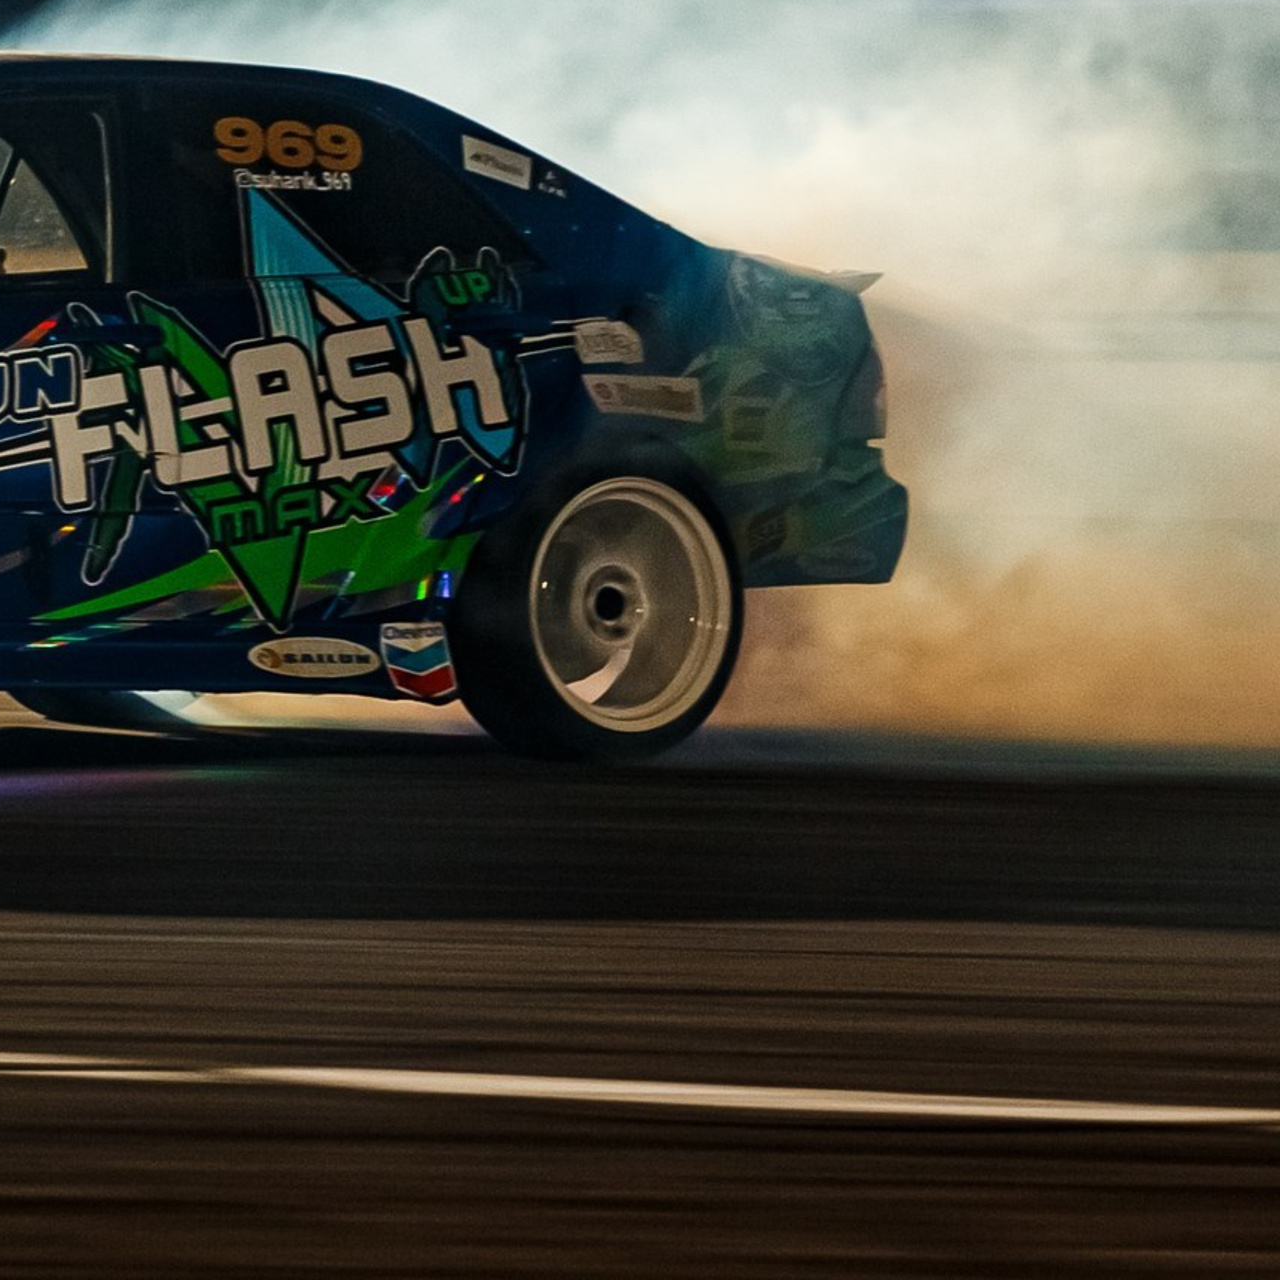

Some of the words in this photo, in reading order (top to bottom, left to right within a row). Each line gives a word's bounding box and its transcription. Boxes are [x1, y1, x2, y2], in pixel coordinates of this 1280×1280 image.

[214, 116, 362, 170] 969
[433, 271, 492, 306] UP
[51, 317, 509, 506] FLASH
[210, 477, 375, 541] MAX
